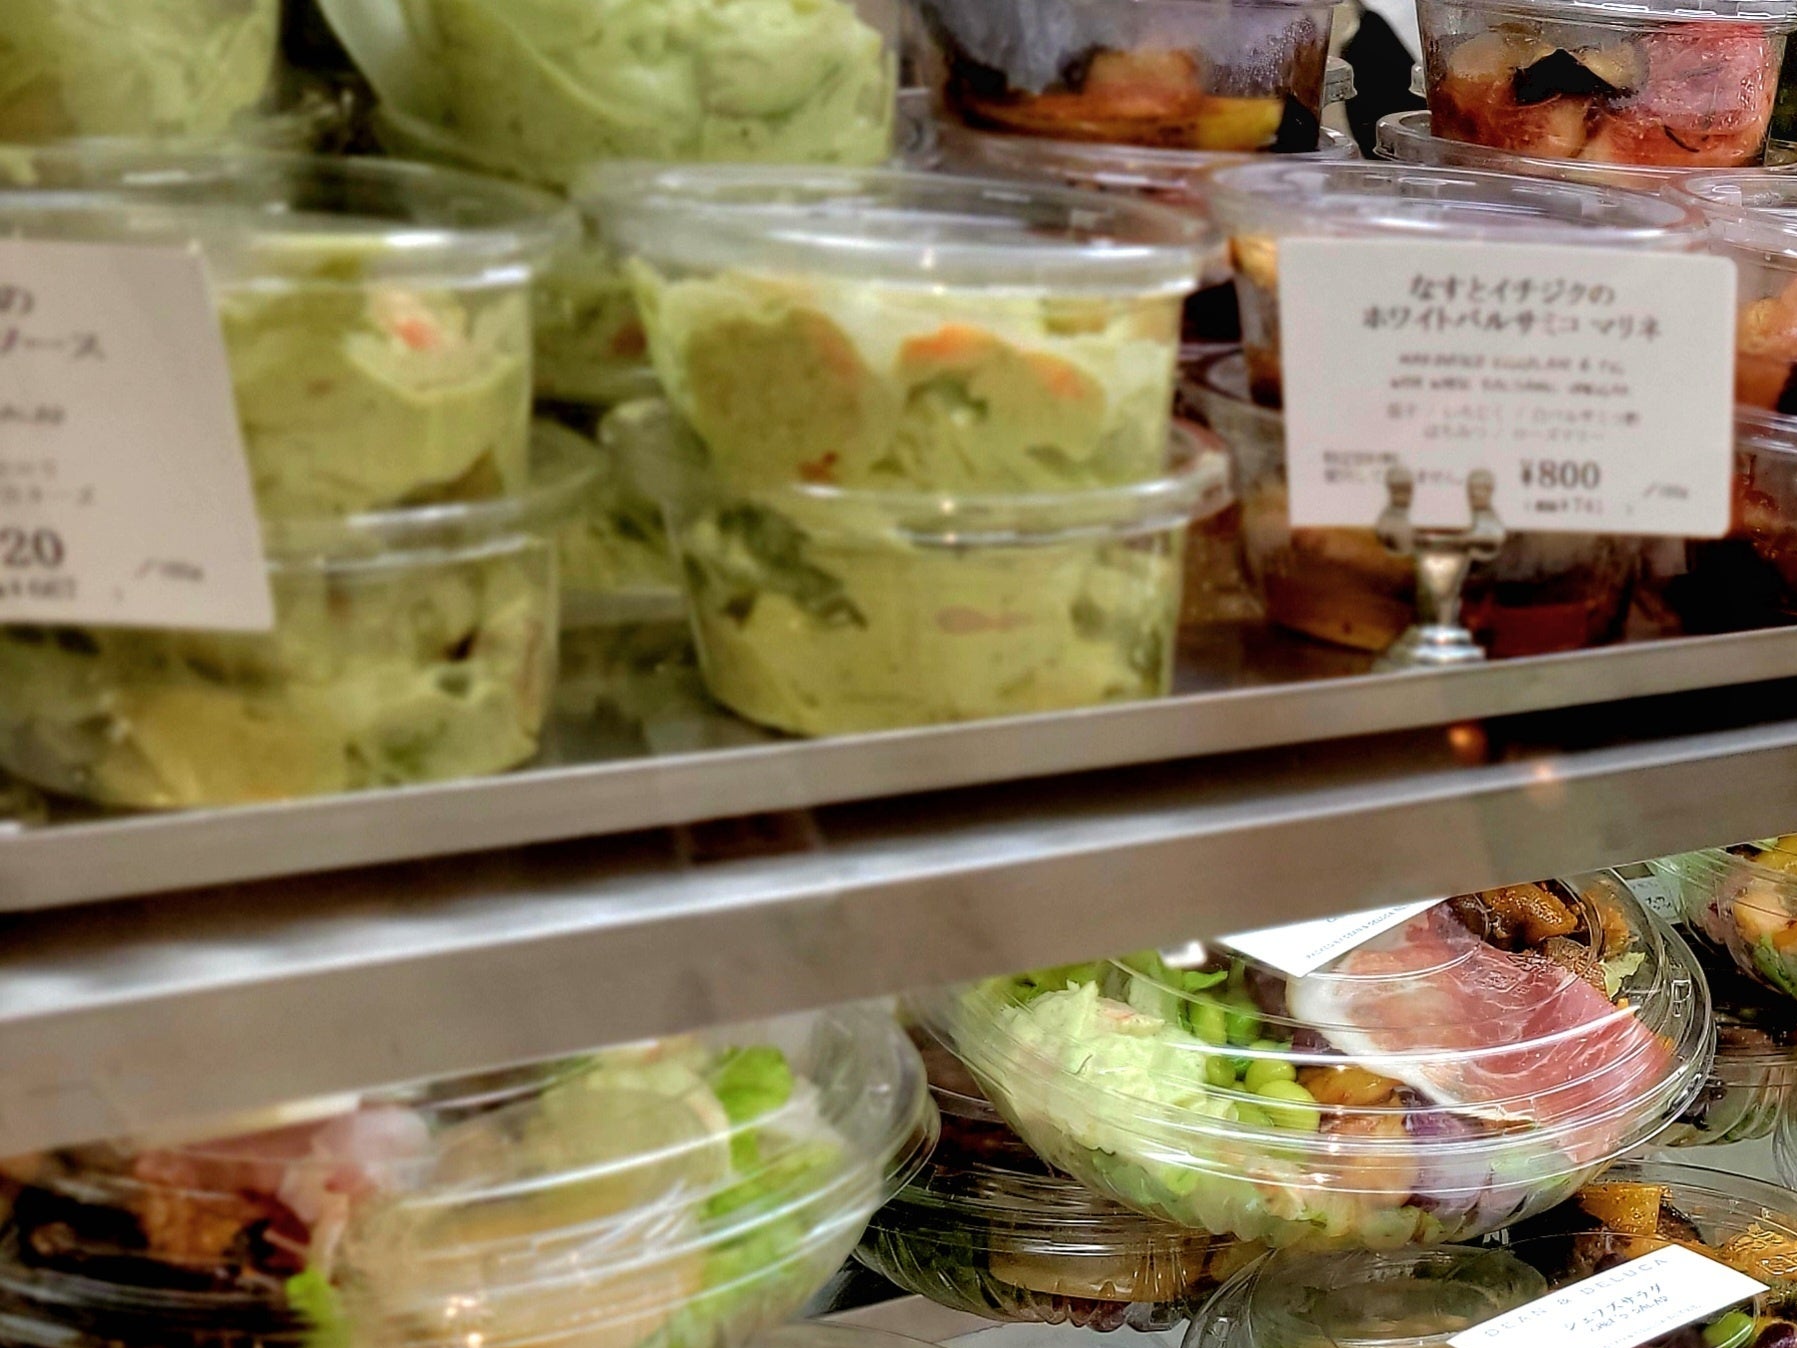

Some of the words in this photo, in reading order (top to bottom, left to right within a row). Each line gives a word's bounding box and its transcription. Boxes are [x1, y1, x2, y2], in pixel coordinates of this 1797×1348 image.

[1410, 273, 1616, 305] なすとイチジクの
[1519, 459, 1602, 490] ¥800
[0, 526, 65, 568] 20
